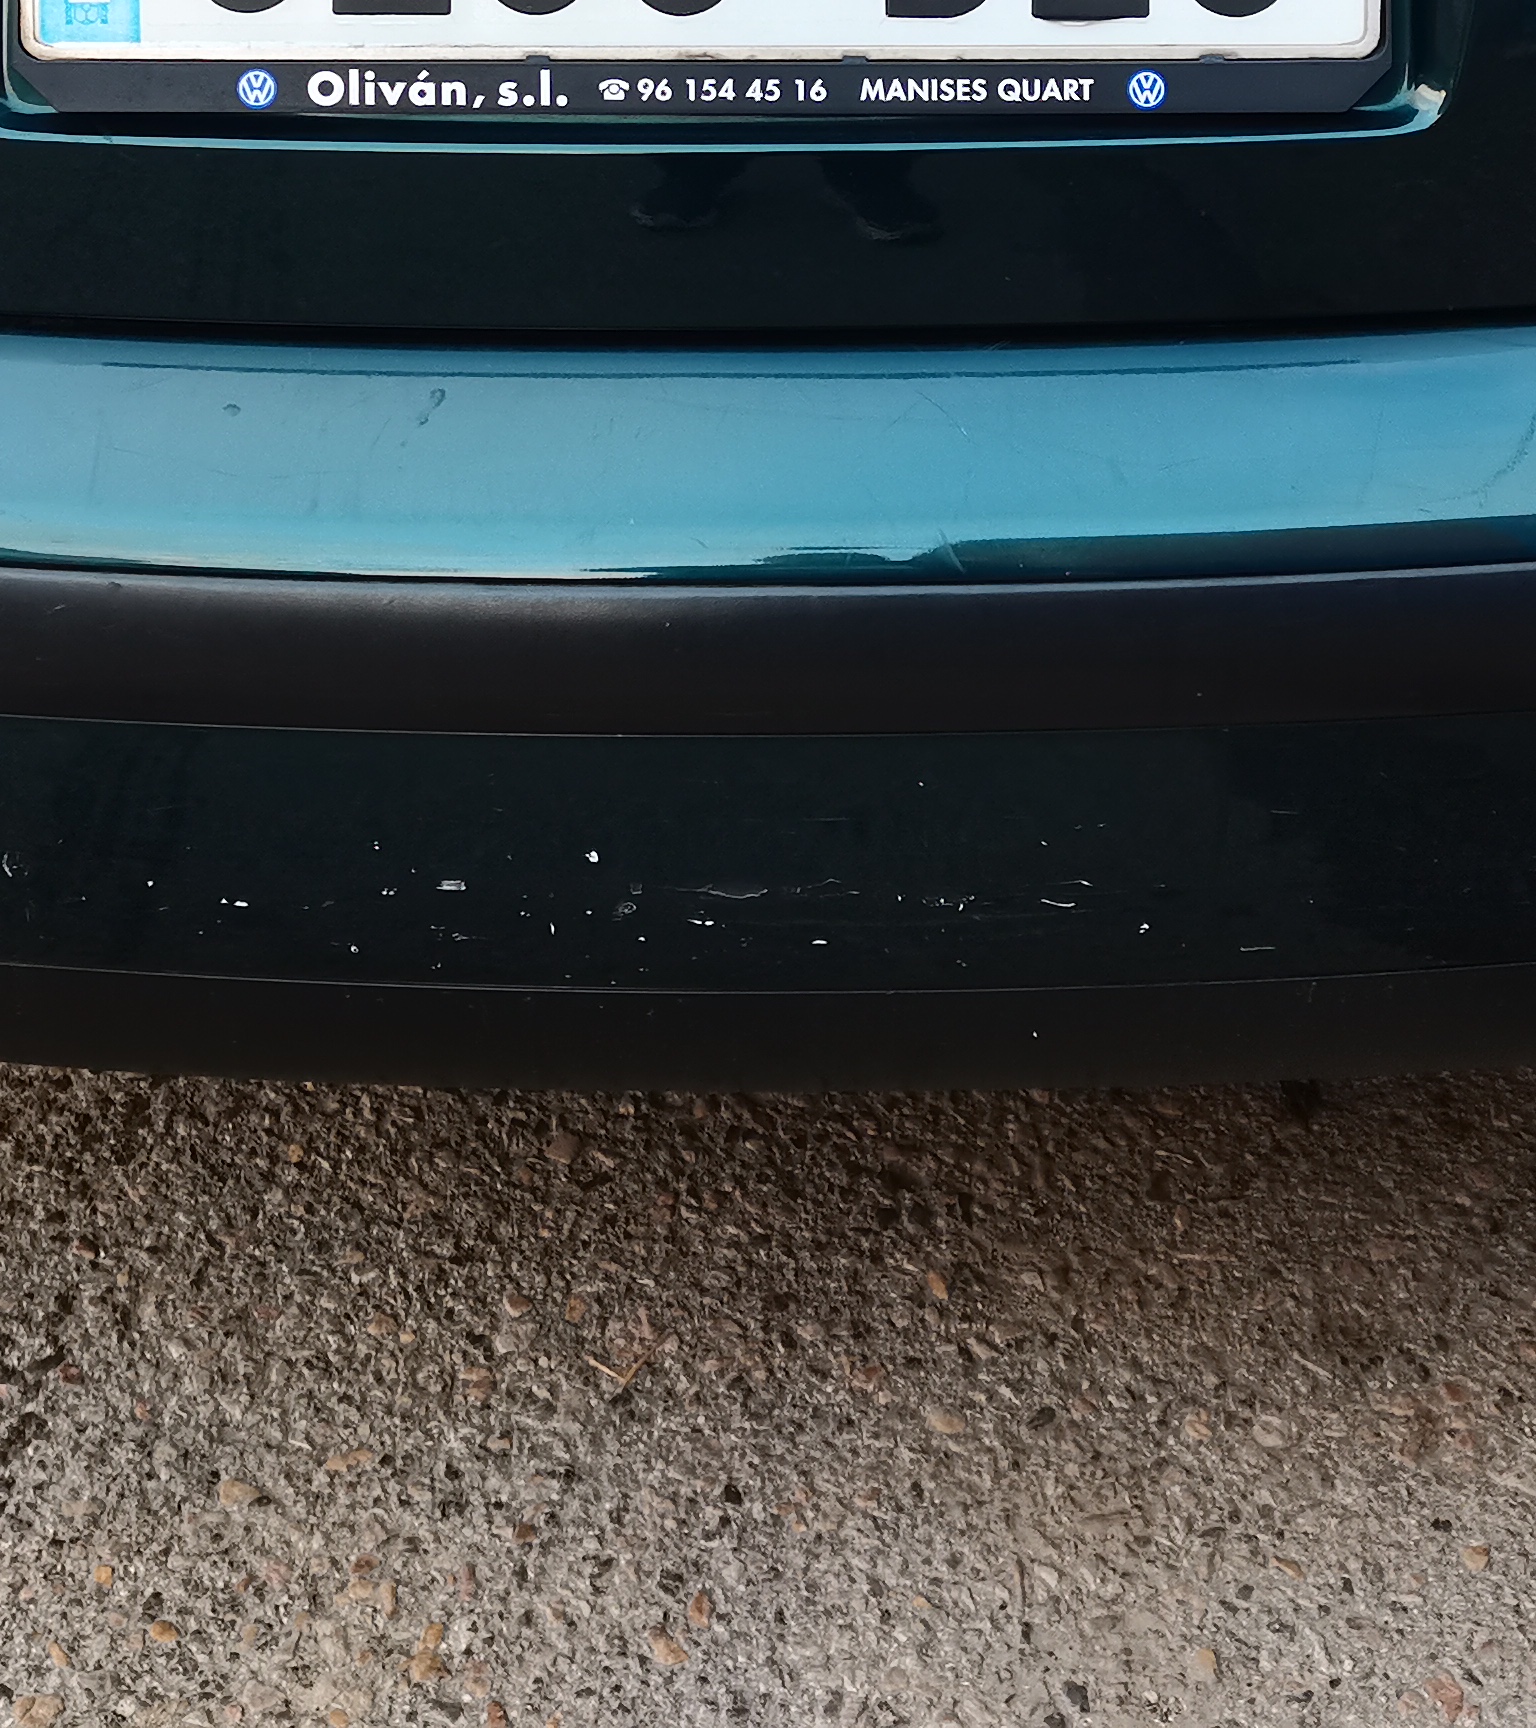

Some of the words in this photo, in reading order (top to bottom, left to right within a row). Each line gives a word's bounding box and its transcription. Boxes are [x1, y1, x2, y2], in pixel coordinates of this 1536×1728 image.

[307, 68, 486, 109] Oliván,
[497, 68, 569, 108] s.l.
[636, 77, 673, 103] 96
[685, 77, 737, 103] 154
[745, 77, 781, 103] 45
[794, 77, 828, 103] 16
[859, 77, 988, 103] MANISES
[997, 77, 1095, 103] QUART
